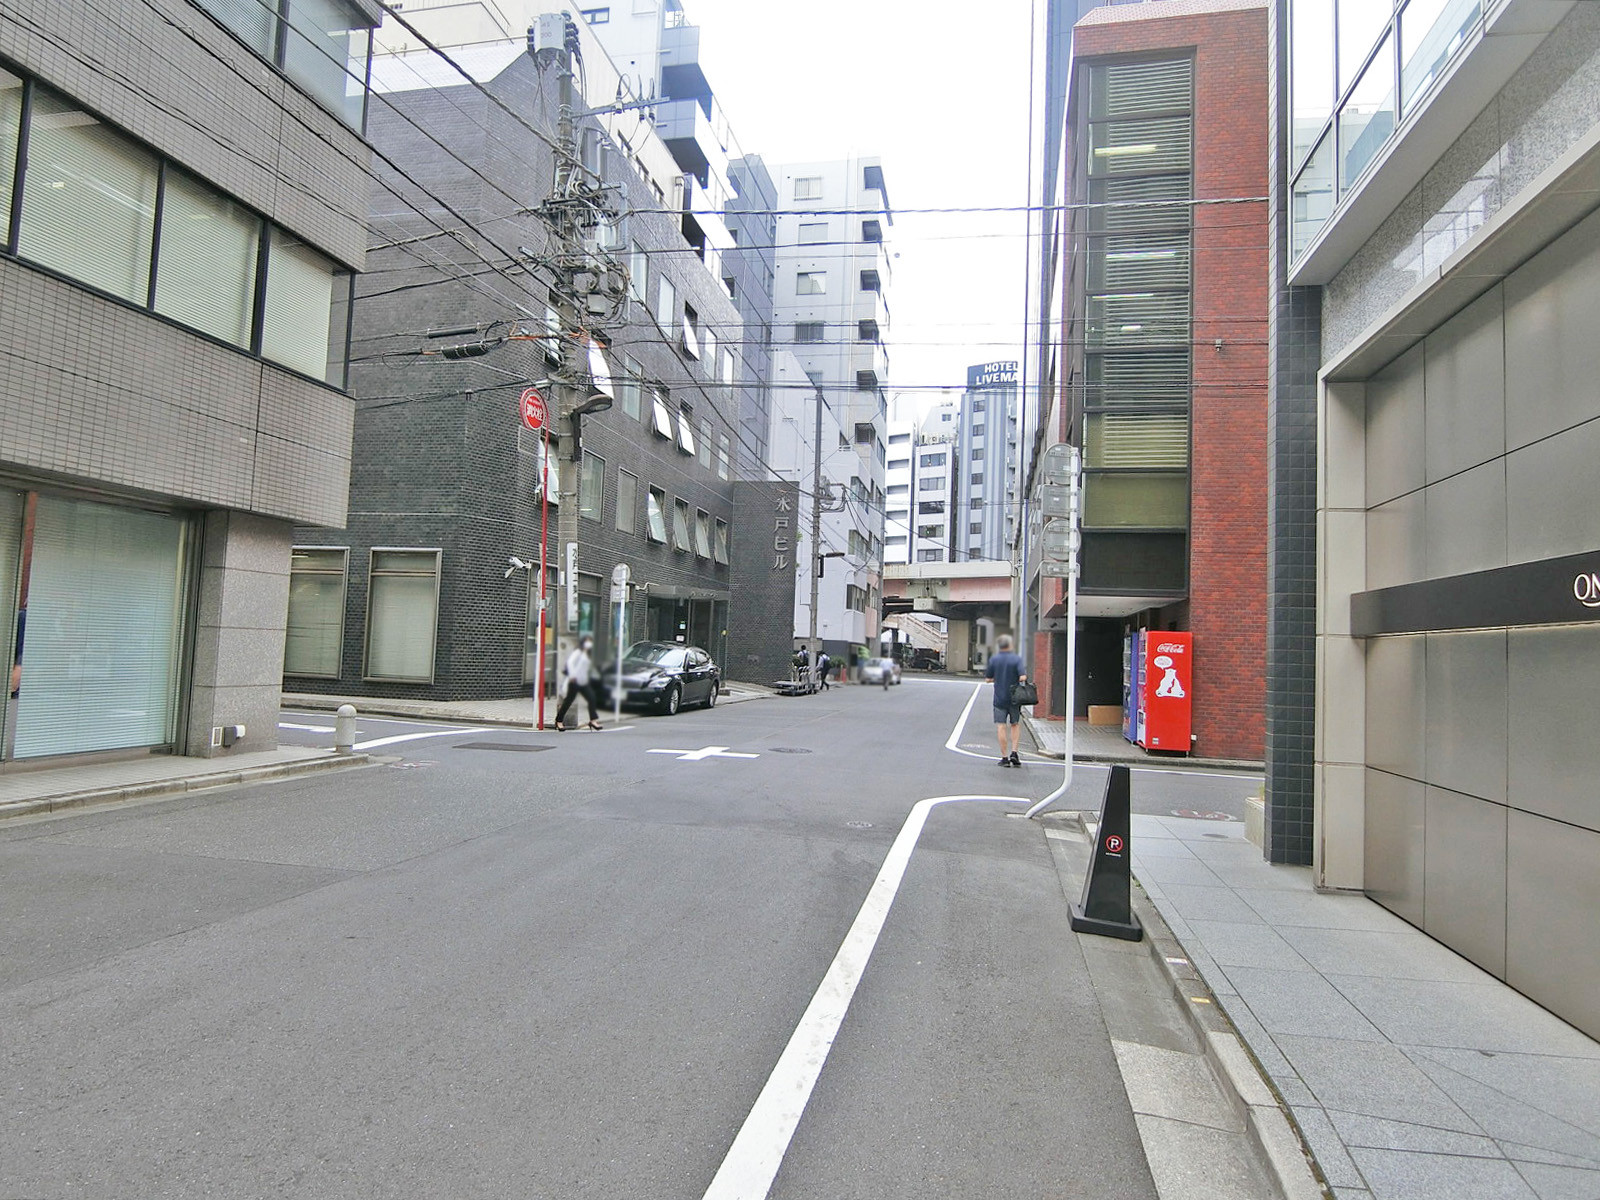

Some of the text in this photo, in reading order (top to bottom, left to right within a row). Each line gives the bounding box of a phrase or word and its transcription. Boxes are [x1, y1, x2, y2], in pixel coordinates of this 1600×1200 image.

[985, 362, 1018, 373] HOTEL
[773, 497, 791, 570] 水戸ビル
